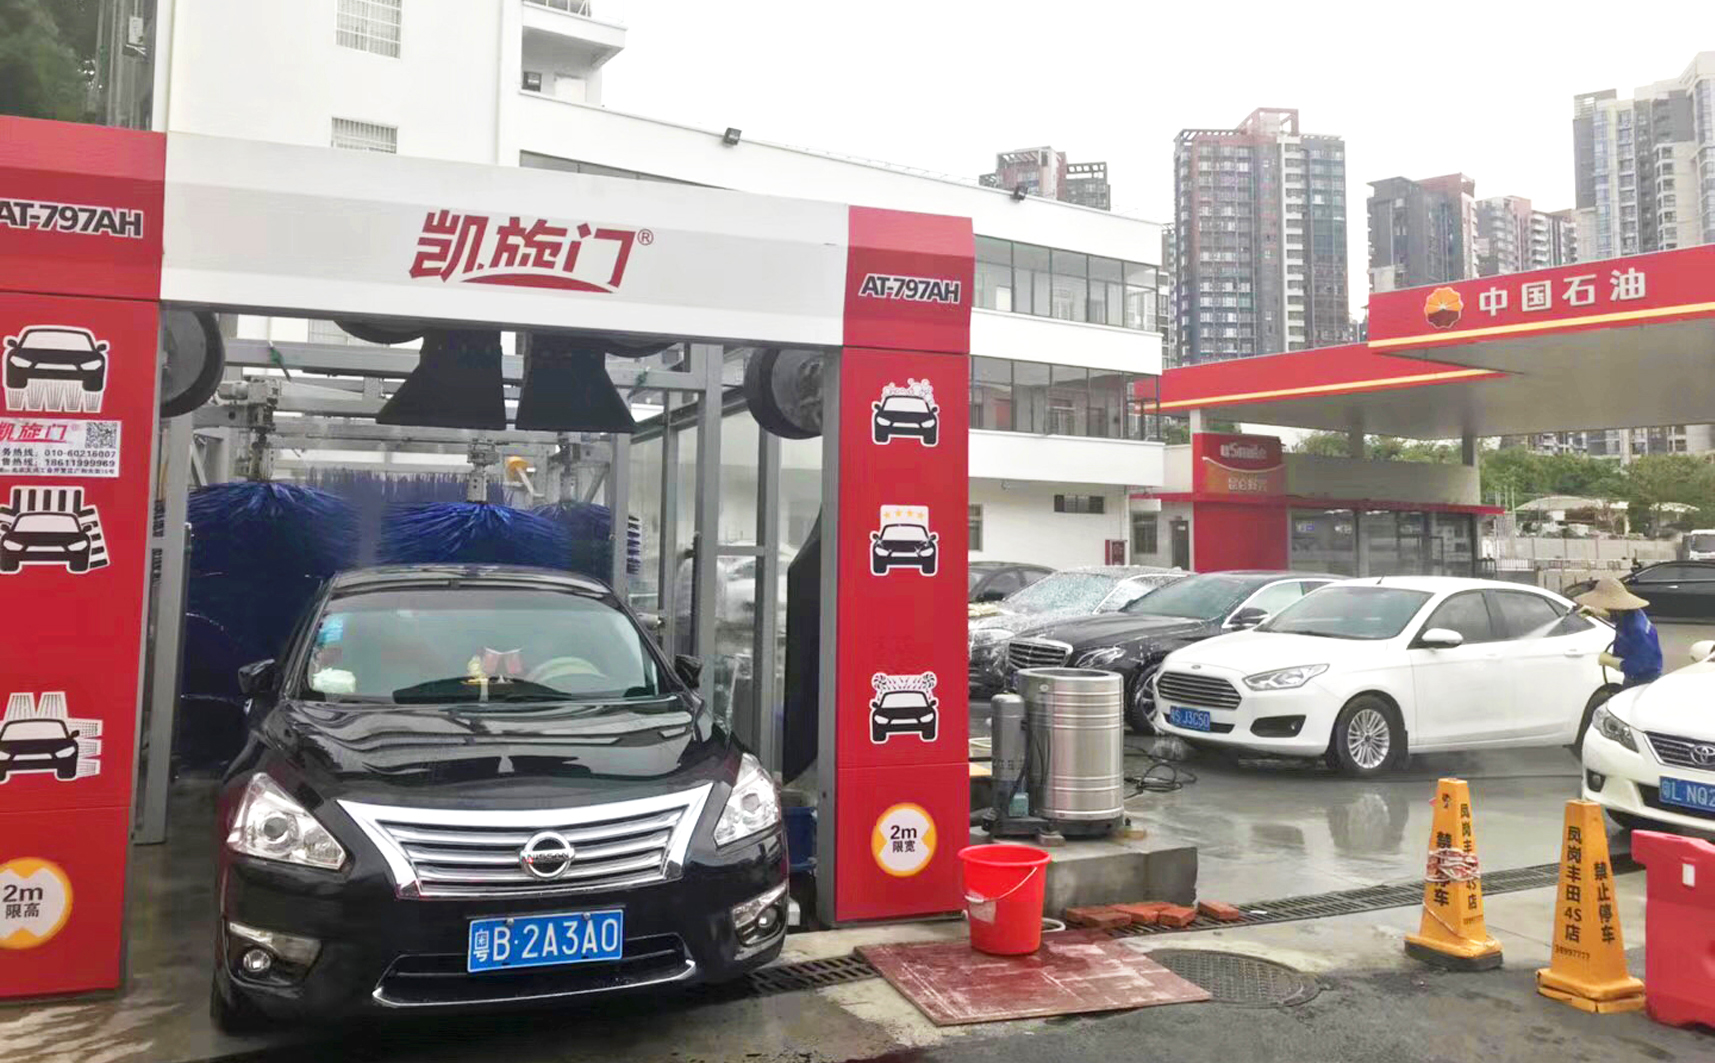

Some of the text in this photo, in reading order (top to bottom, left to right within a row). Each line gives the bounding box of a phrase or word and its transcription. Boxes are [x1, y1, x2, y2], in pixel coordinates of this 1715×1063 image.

[0, 199, 143, 237] AT-797AH
[409, 209, 636, 290] 凯旋门
[860, 274, 960, 303] AT-797AH
[1479, 267, 1646, 316] 中国石油
[890, 825, 917, 840] 2m
[892, 840, 916, 853] 限宽
[3, 884, 44, 902] 2m
[1594, 862, 1615, 943] 禁止停车
[5, 902, 40, 919] 限高
